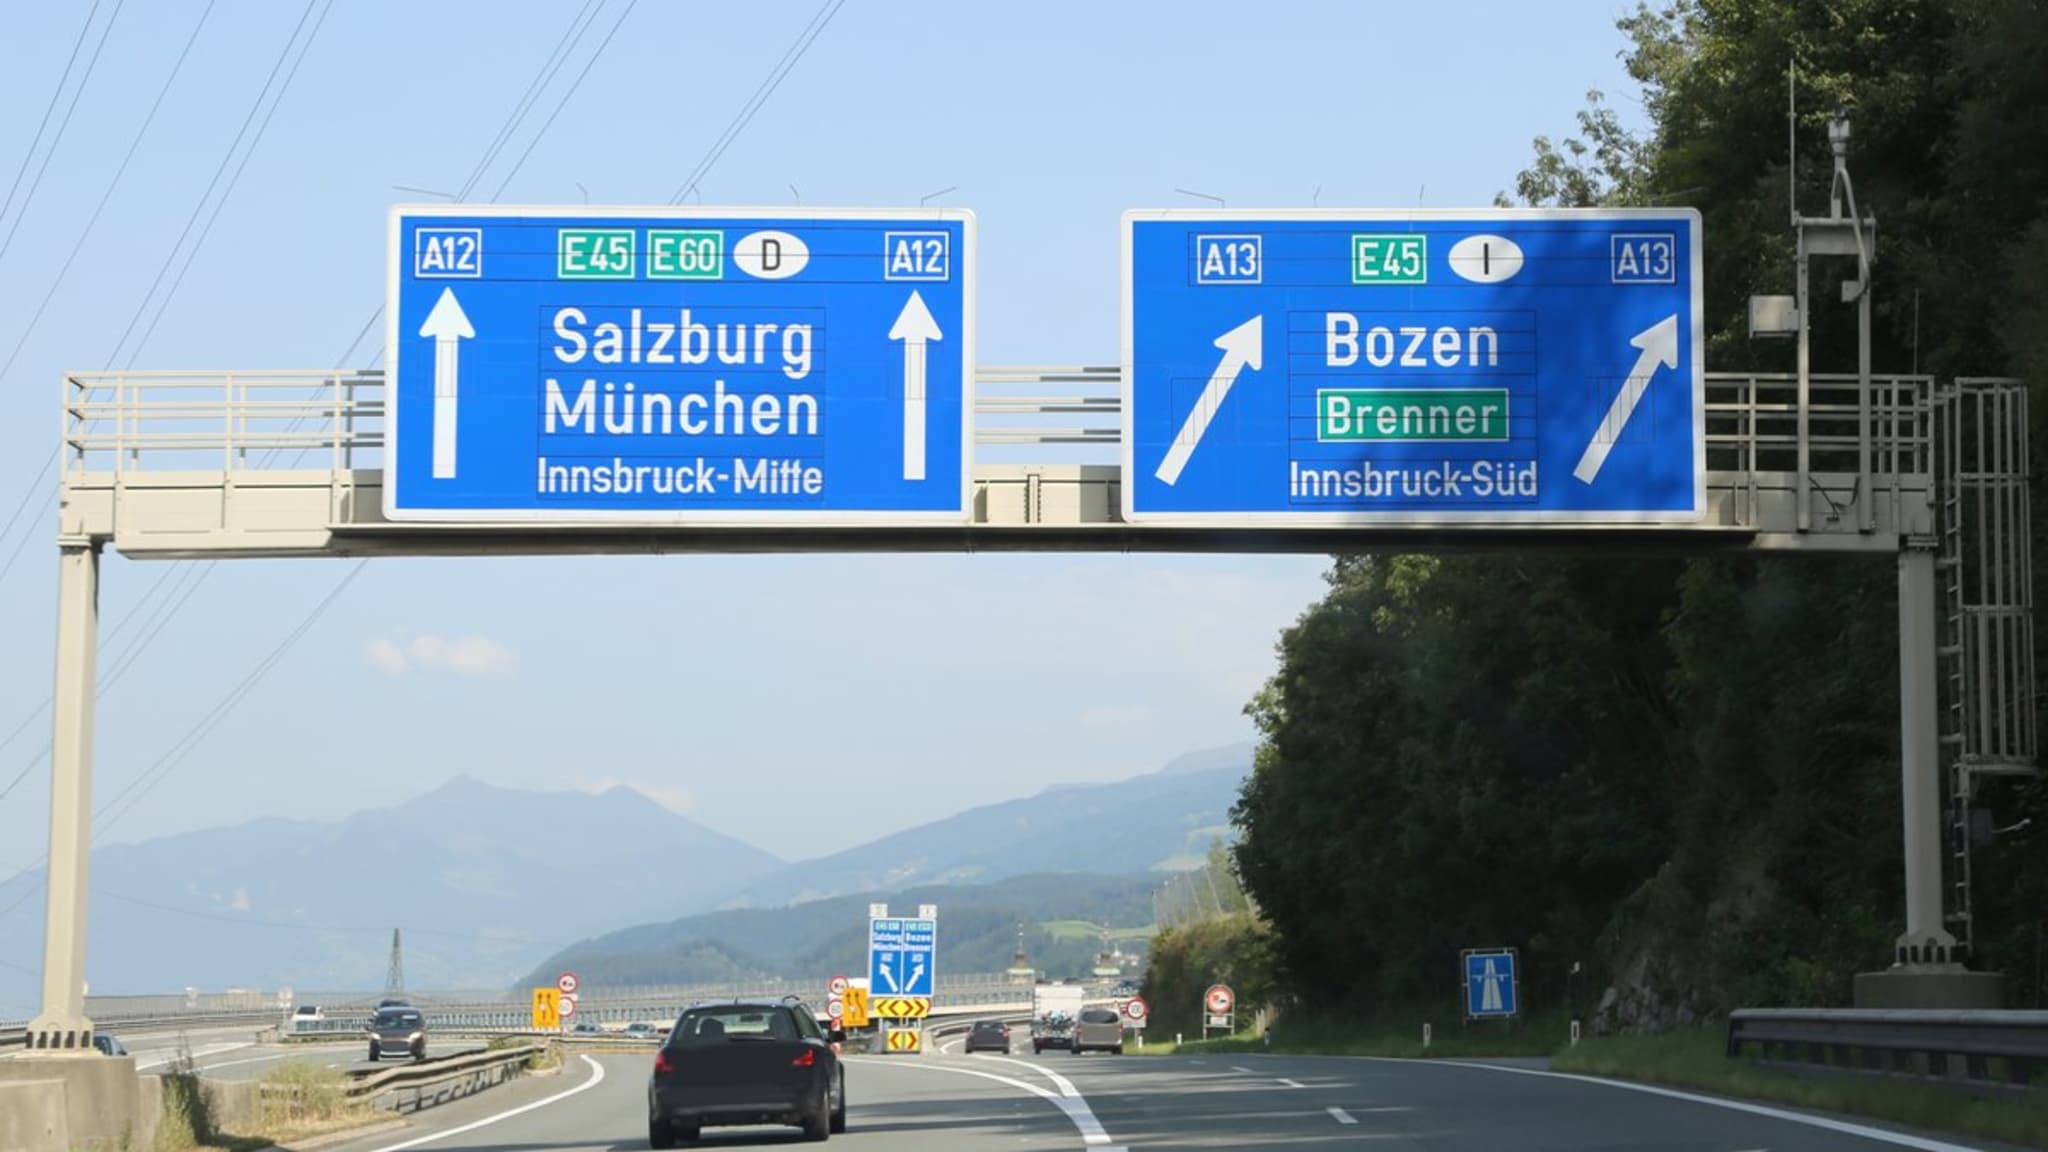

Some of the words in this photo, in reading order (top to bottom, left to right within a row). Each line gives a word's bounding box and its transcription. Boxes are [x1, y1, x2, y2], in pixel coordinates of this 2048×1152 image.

[421, 236, 475, 270] A12
[564, 236, 628, 271] E45
[654, 238, 717, 272] E60
[761, 240, 781, 271] D
[892, 240, 943, 273] A12
[1203, 242, 1257, 275] A13
[1358, 242, 1420, 276] E45
[1617, 242, 1669, 274] A13
[552, 307, 813, 379] Salzburg
[1326, 312, 1498, 367] Bozen
[544, 379, 819, 435] München
[1326, 396, 1498, 434] Brenner
[537, 457, 824, 494] Innsbruck-Mitte
[1290, 460, 1538, 497] Innsbruck-Süd
